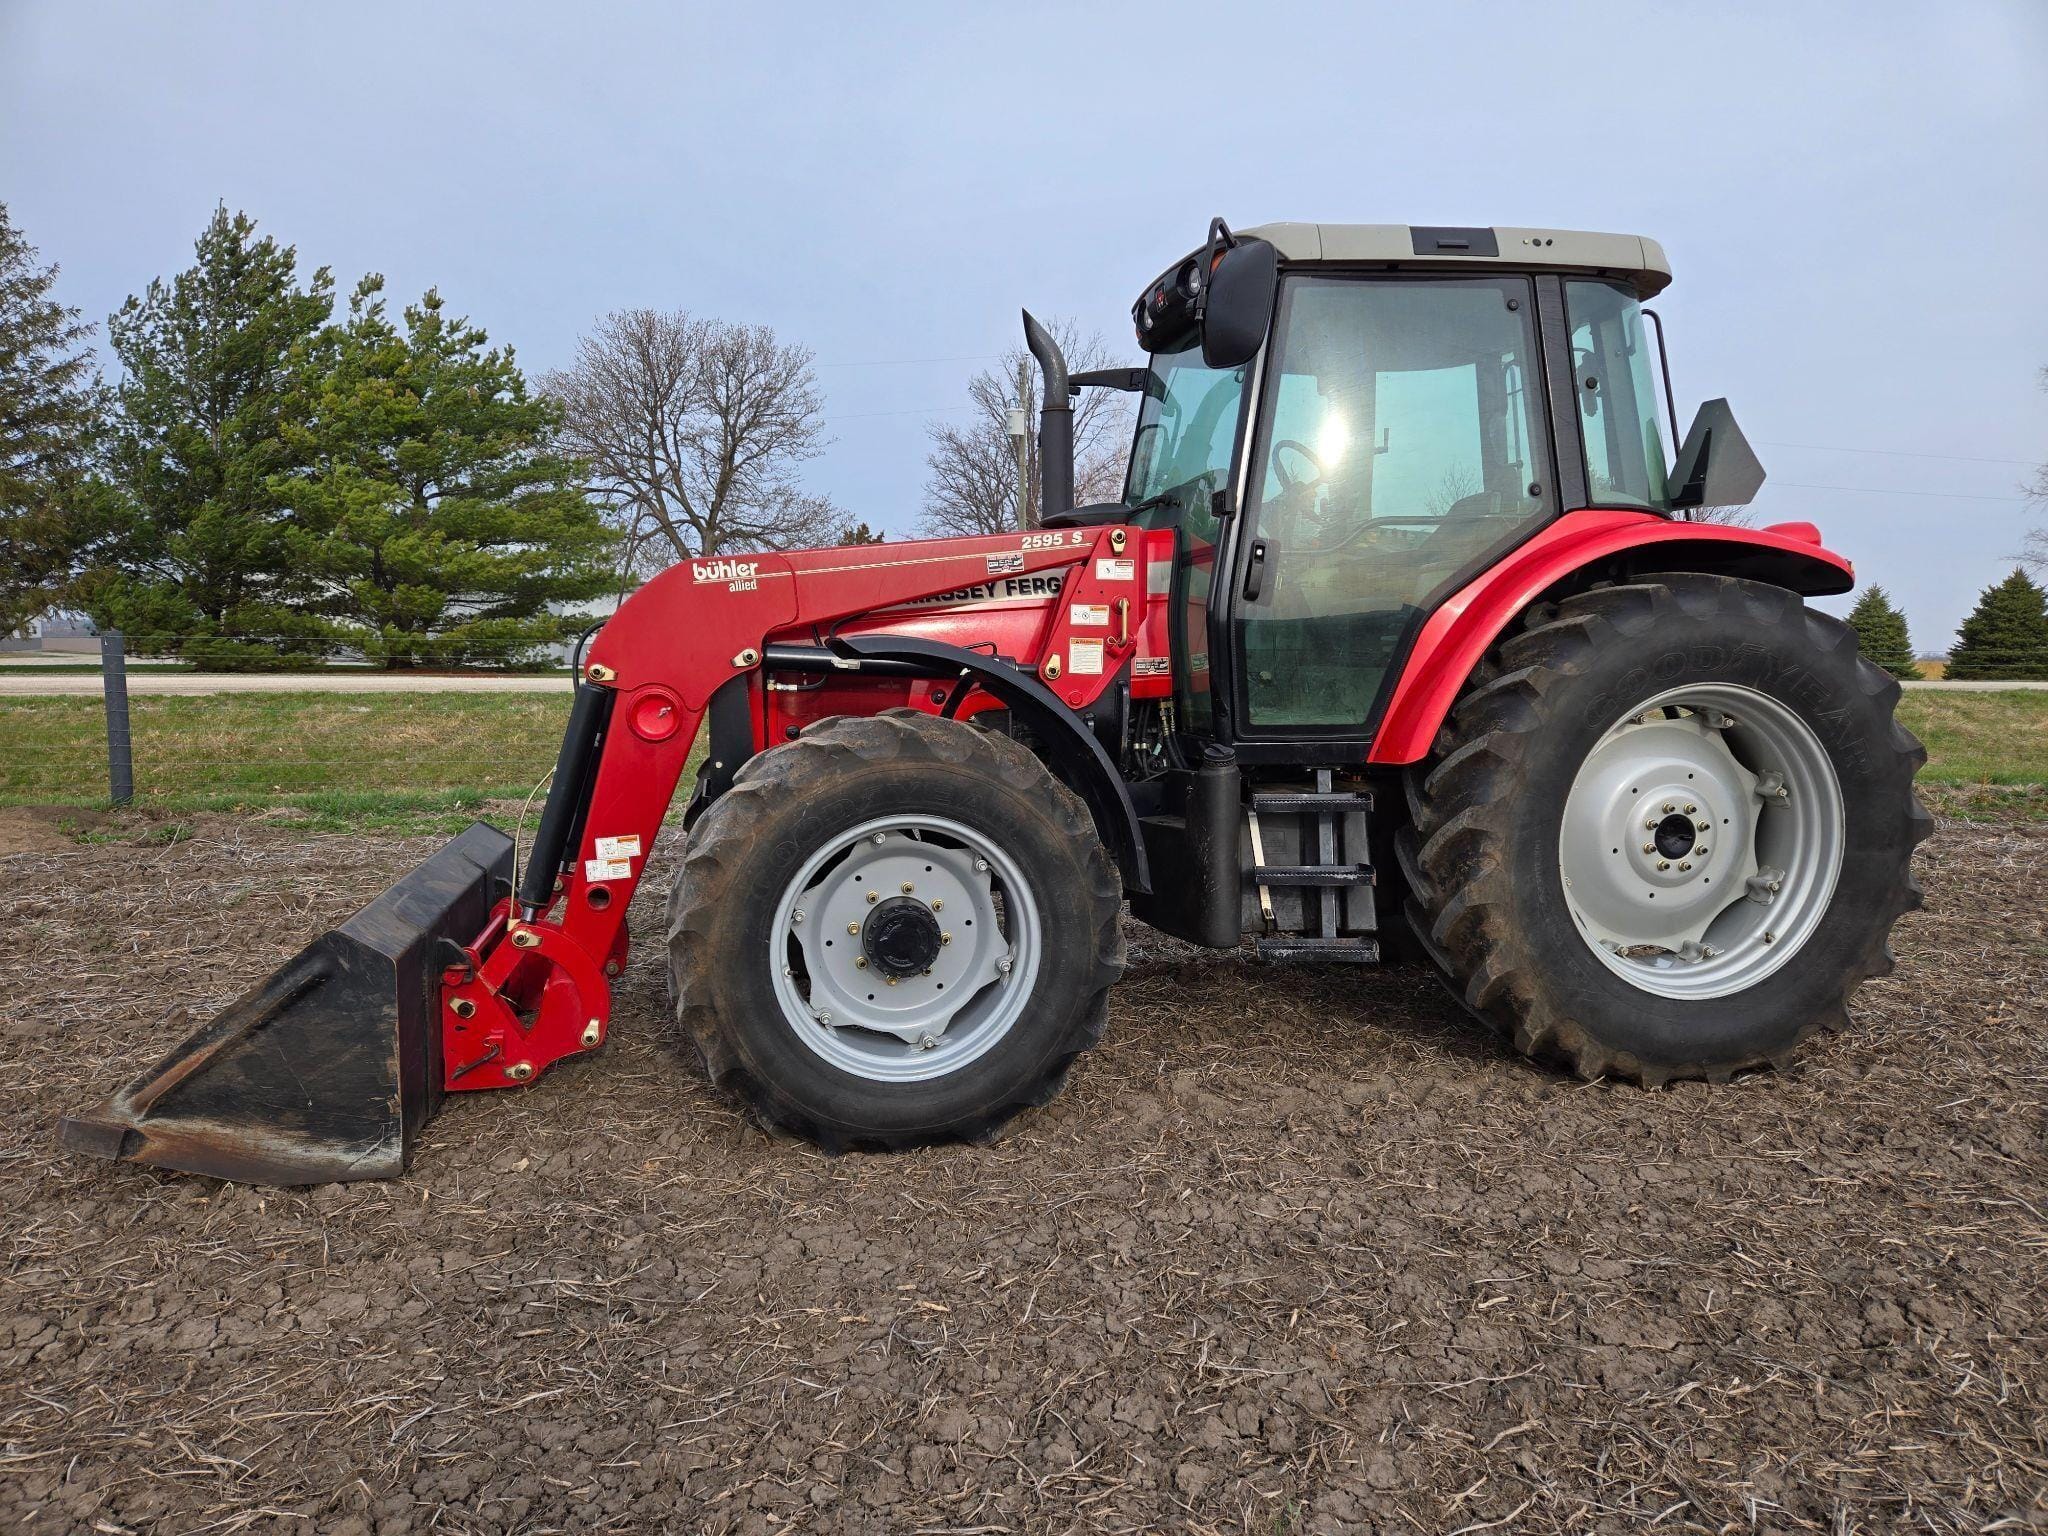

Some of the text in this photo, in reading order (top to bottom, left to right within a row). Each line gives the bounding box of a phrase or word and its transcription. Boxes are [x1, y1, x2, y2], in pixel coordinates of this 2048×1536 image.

[1021, 531, 1083, 549] 2595 S
[693, 560, 758, 580] bühler
[729, 579, 757, 592] allied
[1005, 576, 1064, 597] FERG
[1584, 643, 1873, 776] GOODYEAR
